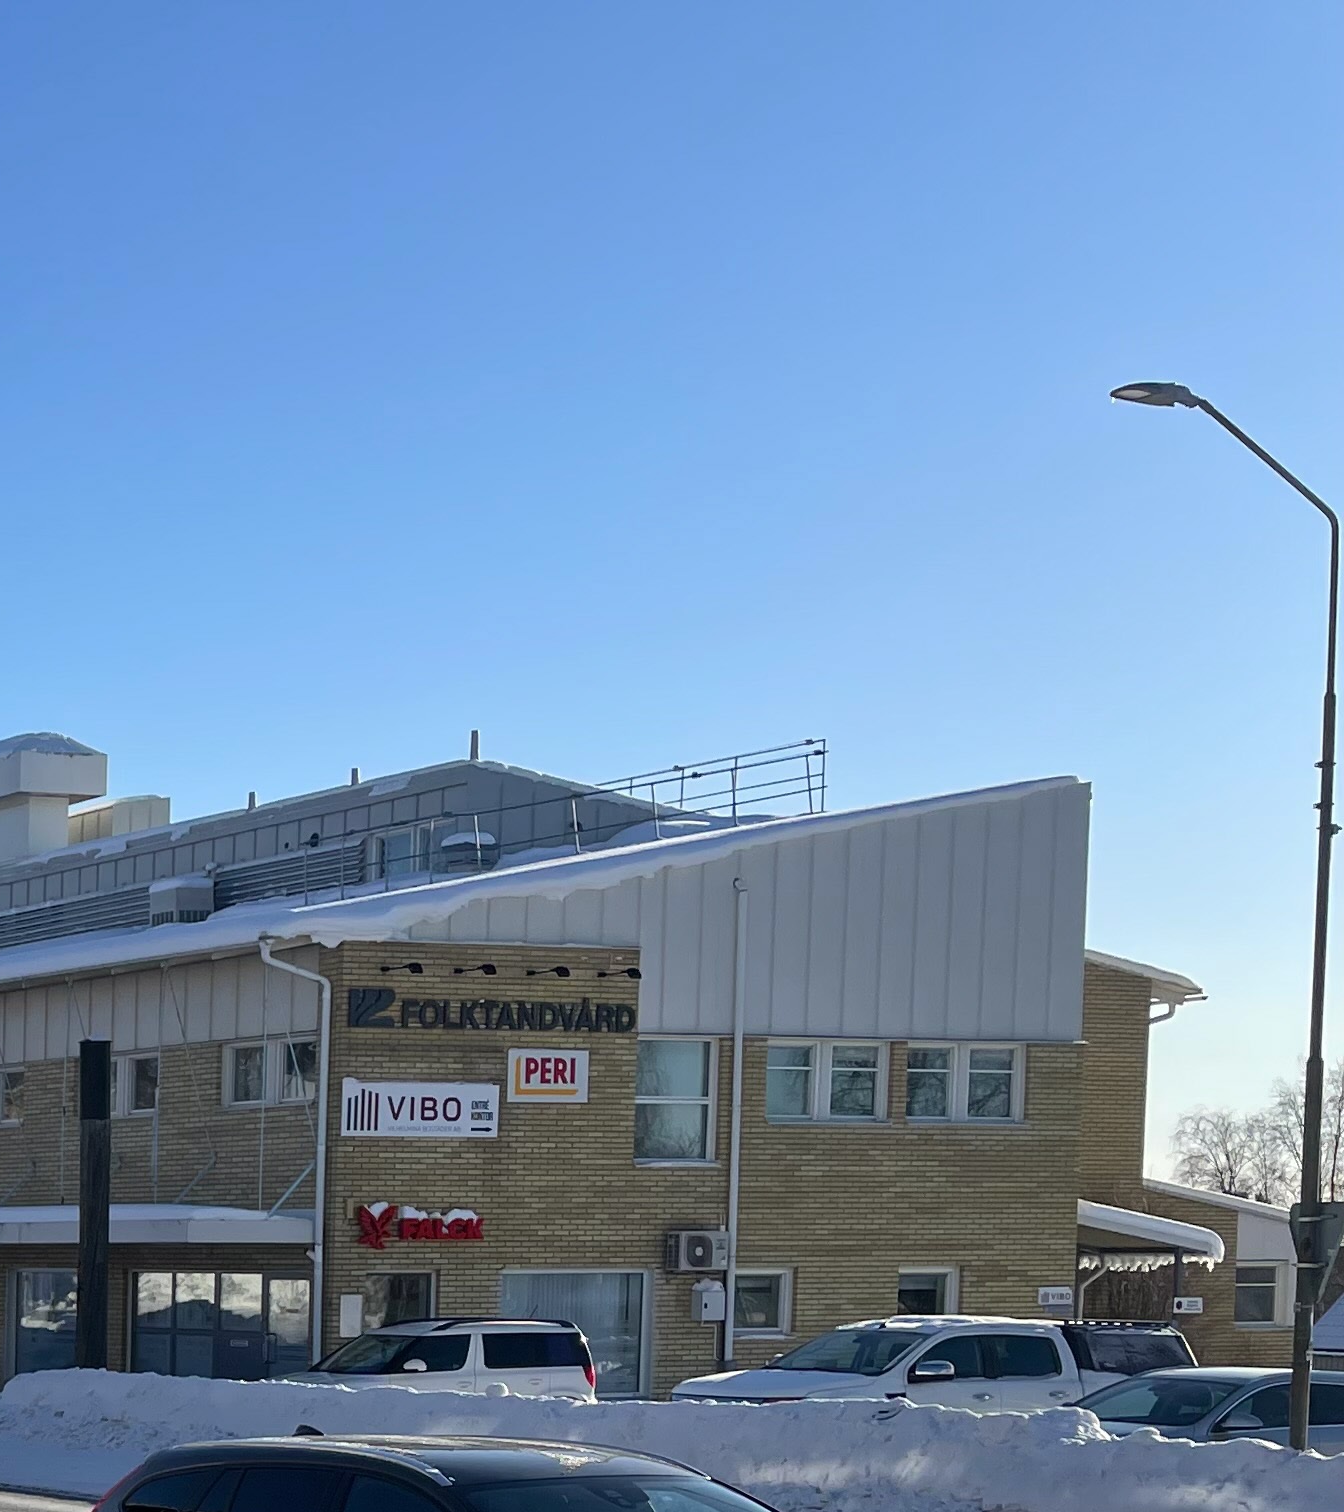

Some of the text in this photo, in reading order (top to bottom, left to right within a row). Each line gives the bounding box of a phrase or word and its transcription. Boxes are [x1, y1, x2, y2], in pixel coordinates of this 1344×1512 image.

[401, 997, 636, 1033] FOLKTANDVÅRD
[524, 1056, 576, 1084] PERI
[387, 1095, 462, 1121] VIBO
[399, 1216, 485, 1241] FALCK
[1051, 1292, 1071, 1301] VIBO
